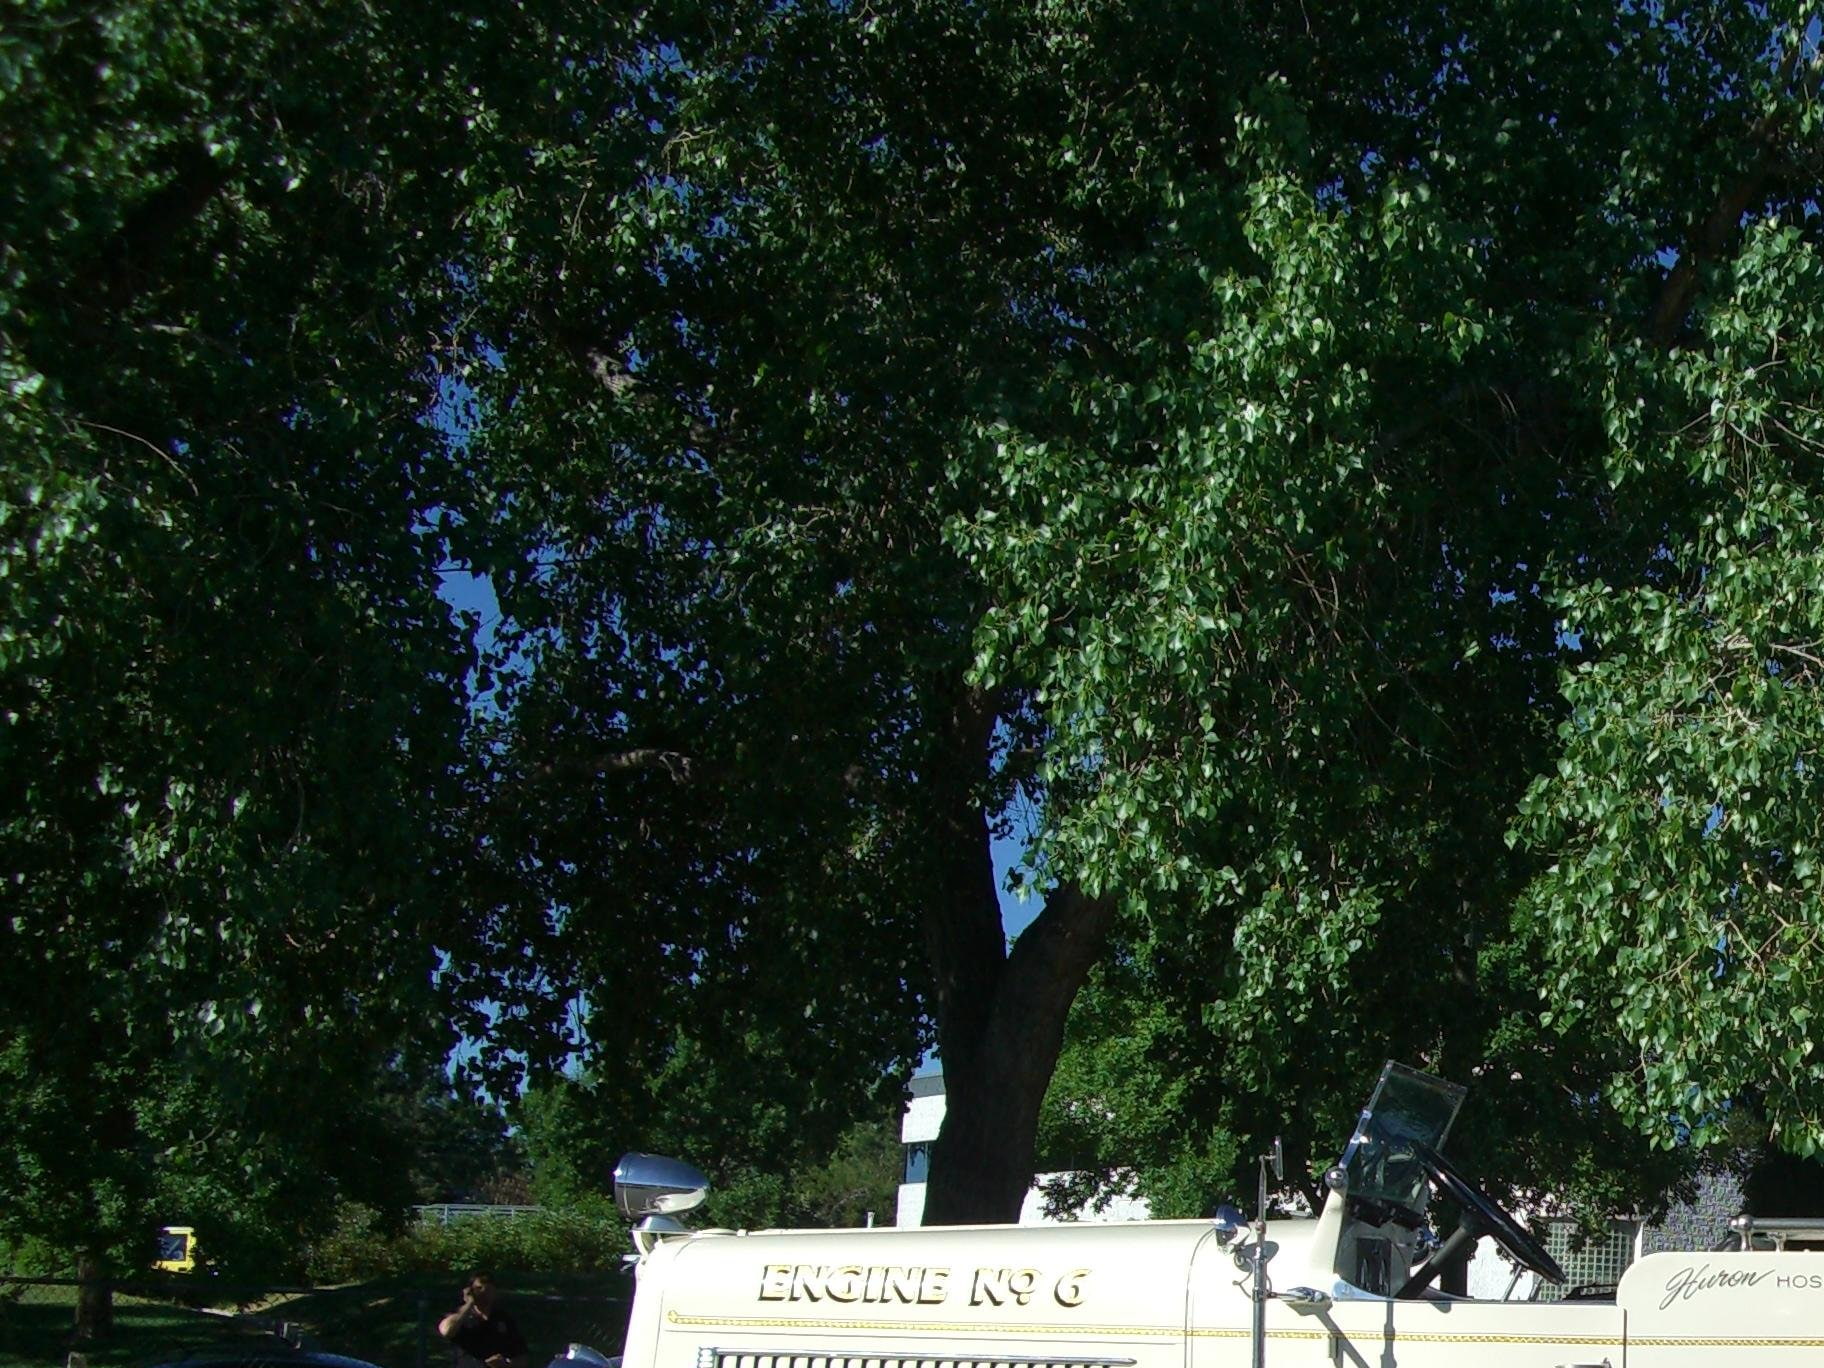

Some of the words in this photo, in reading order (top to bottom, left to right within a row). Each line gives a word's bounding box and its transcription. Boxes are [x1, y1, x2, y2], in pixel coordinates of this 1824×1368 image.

[758, 1264, 951, 1305] ENGINE
[1053, 1268, 1092, 1307] 6
[1658, 1263, 1776, 1311] Huron
